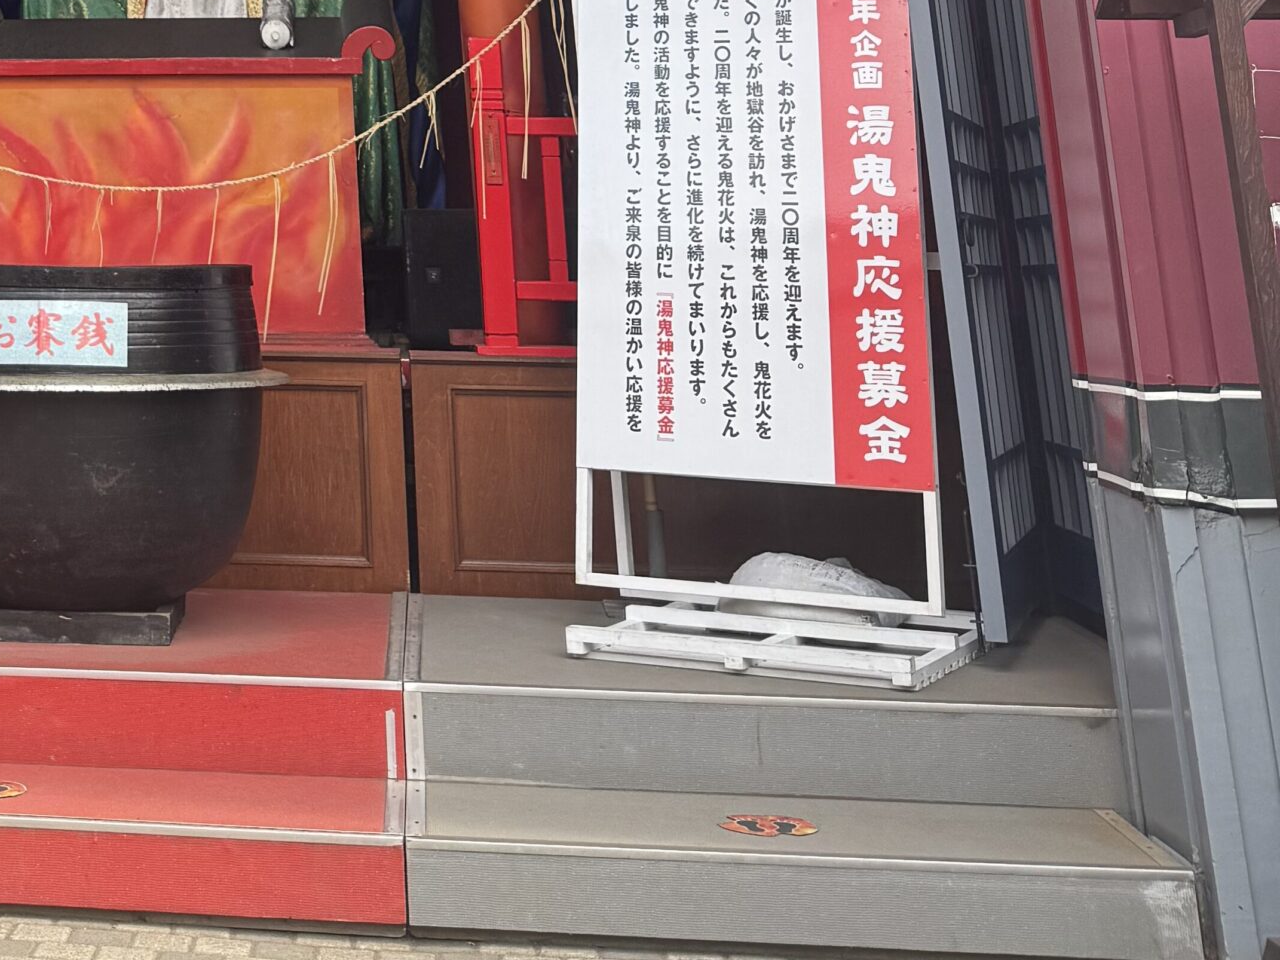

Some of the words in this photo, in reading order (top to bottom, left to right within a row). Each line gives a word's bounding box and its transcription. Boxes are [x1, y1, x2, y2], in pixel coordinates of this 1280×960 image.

[846, 104, 911, 464] 湯鬼神応援募金
